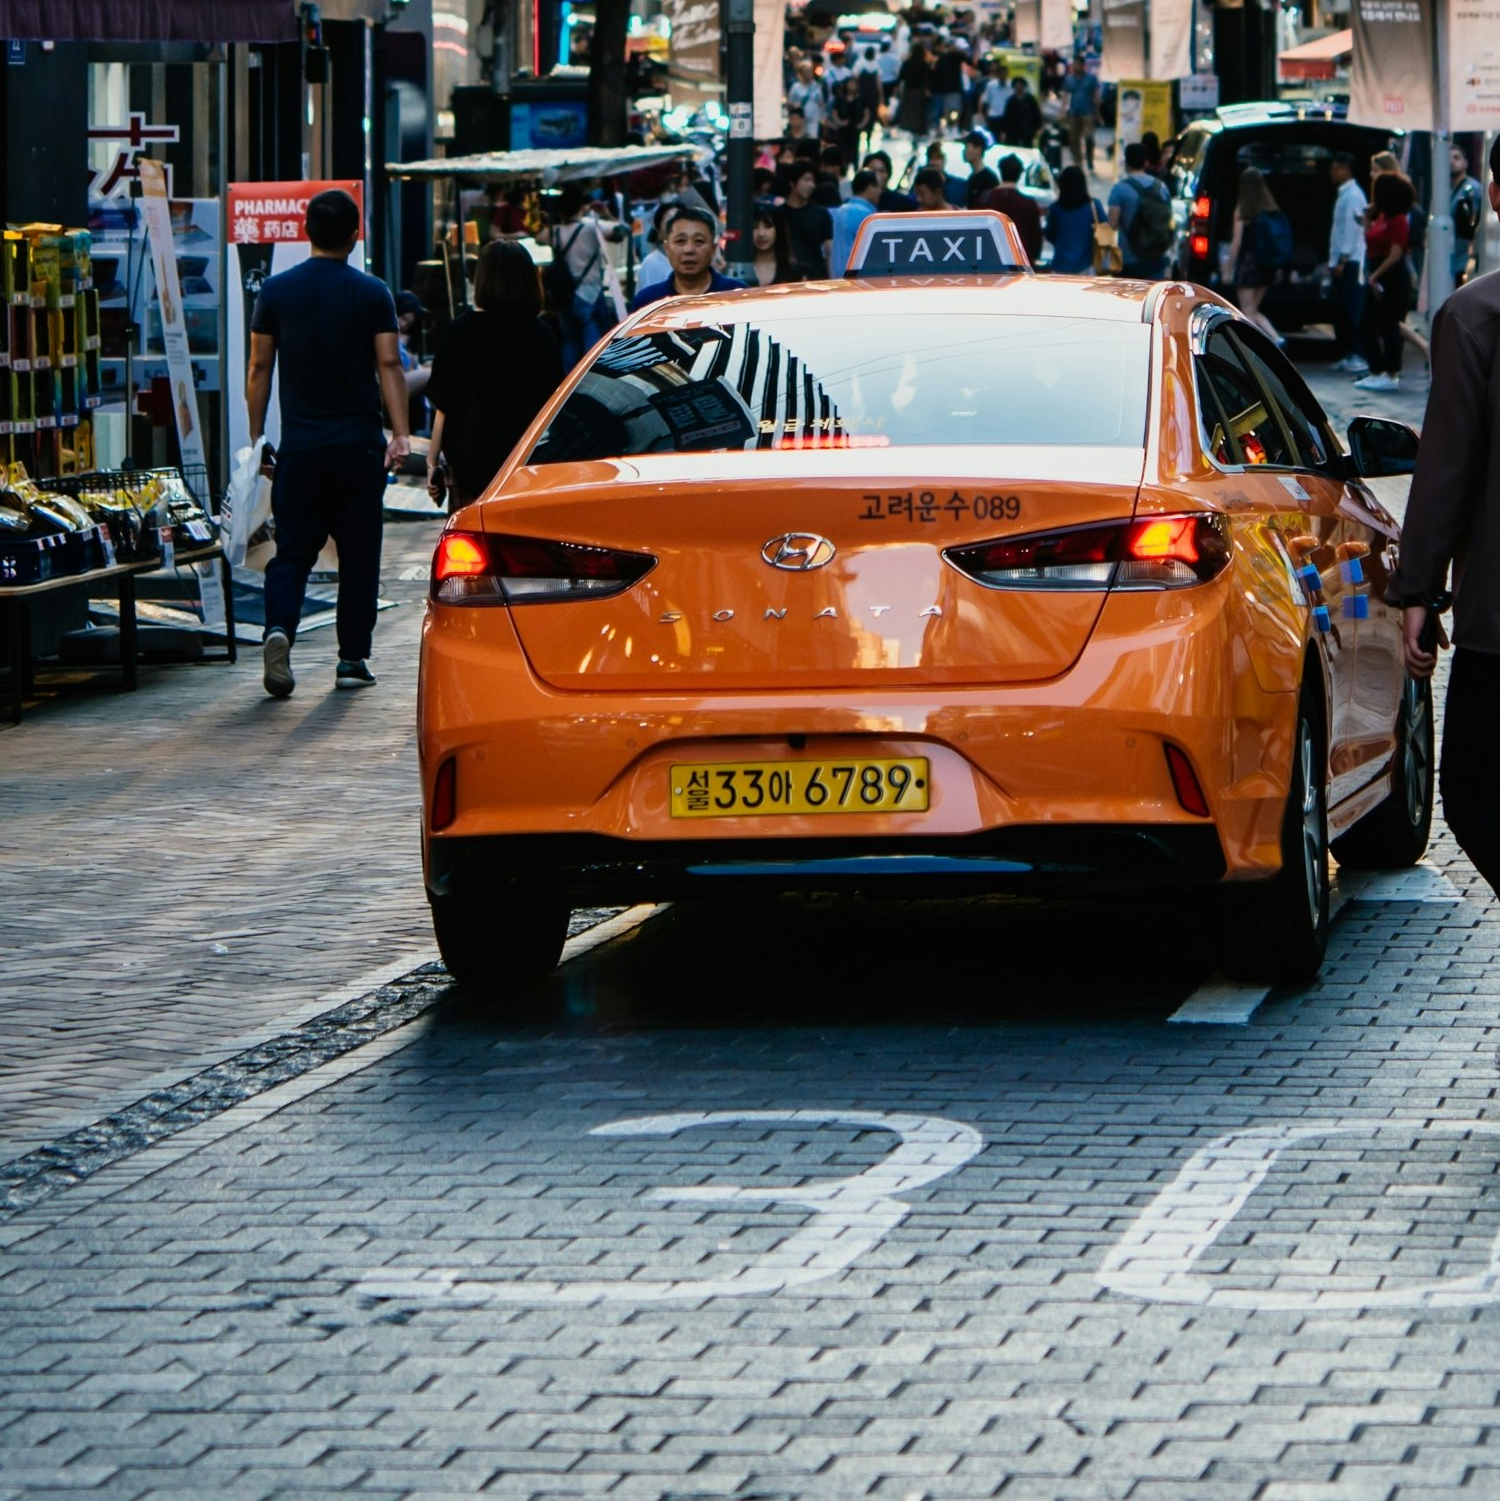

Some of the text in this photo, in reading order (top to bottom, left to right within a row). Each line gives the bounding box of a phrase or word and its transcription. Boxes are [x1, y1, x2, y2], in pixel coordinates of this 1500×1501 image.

[233, 217, 299, 244] 藥 药店
[881, 235, 984, 263] TAXI
[658, 605, 944, 623] SONATA
[686, 769, 710, 811] 서울
[804, 764, 912, 806] 6789
